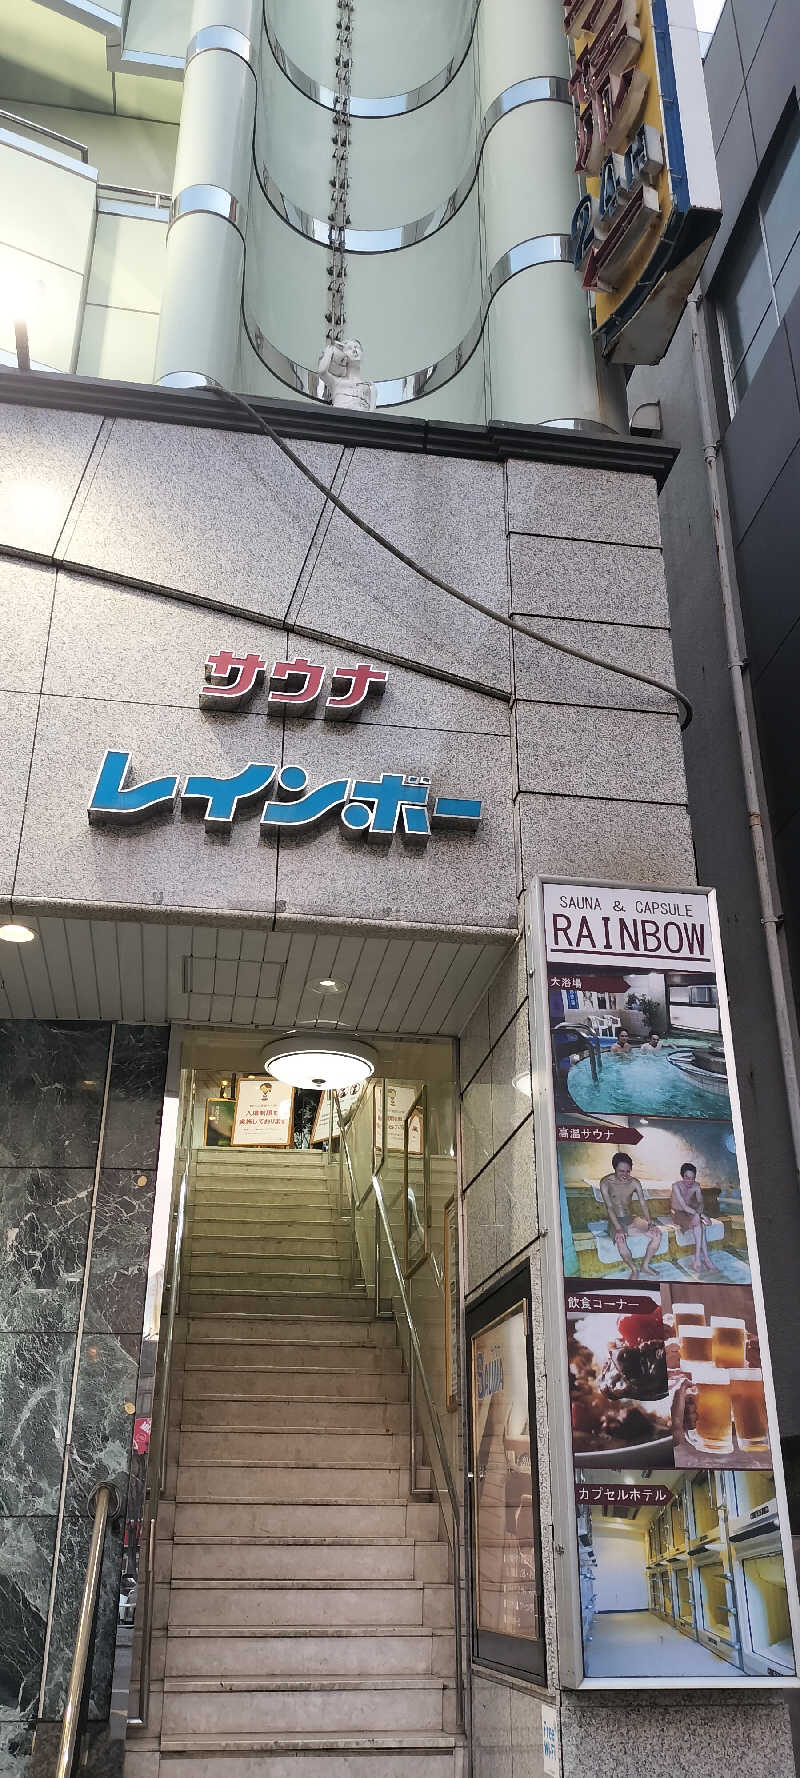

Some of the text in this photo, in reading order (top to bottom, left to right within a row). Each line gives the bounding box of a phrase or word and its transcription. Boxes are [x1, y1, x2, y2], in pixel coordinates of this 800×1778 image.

[199, 651, 388, 712] サウナ
[88, 750, 482, 837] レインボー
[559, 895, 694, 918] SAUNA & CAPSULE
[551, 913, 706, 956] RAINBOW
[550, 976, 583, 989] 大浴場
[558, 1127, 615, 1141] 高温サウナ
[567, 1296, 640, 1310] 飲食コーナー
[578, 1487, 668, 1502] カプセルホテル
